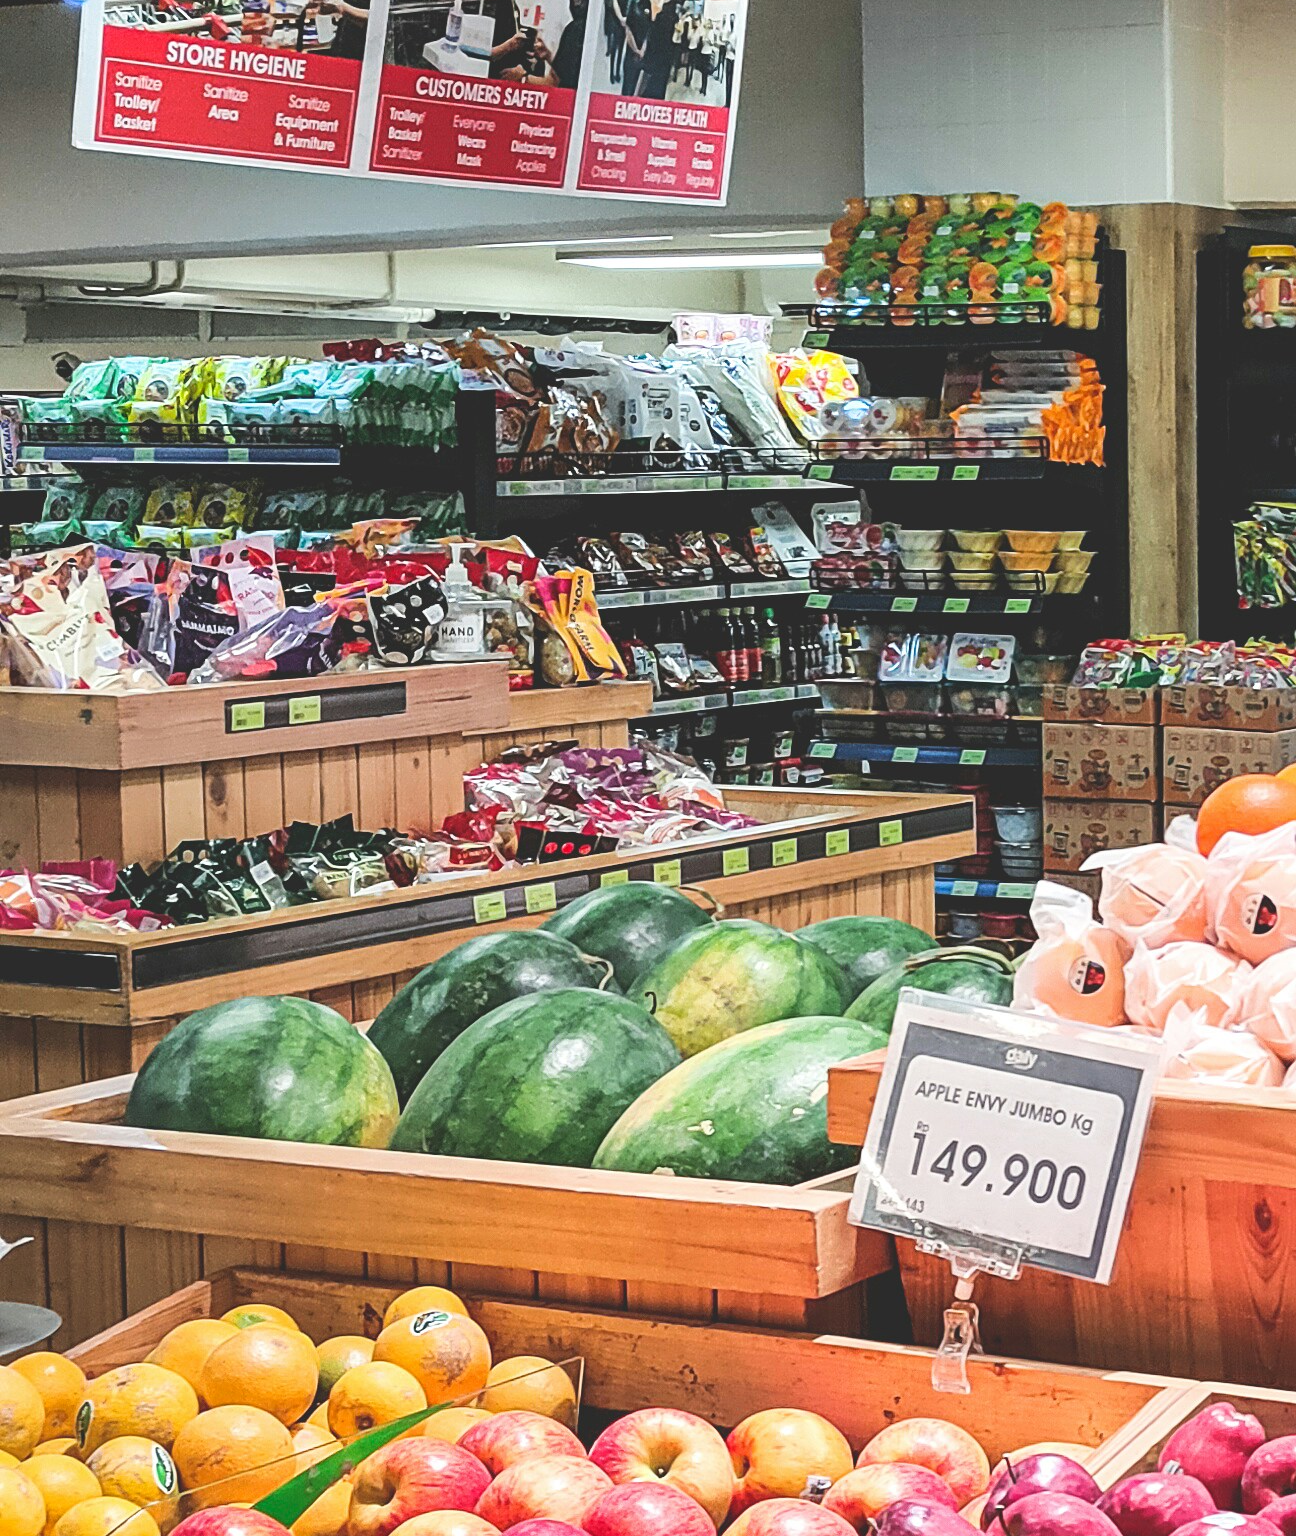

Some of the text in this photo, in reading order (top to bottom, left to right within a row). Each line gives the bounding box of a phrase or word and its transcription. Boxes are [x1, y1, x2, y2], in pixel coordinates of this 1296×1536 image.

[166, 41, 307, 79] STORE HYGIENE
[115, 72, 163, 92] Sanitize
[203, 83, 249, 103] Sanitize
[415, 76, 549, 110] CUSTOMERS SAFETY
[208, 105, 239, 121] Area
[288, 94, 331, 113] Sanitize
[113, 114, 157, 132] Basket
[275, 112, 339, 133] Equipment
[614, 101, 709, 128] EMPLOYEES HEALTH
[273, 132, 335, 152] & Furniture
[441, 626, 474, 636] HAND
[915, 1080, 1094, 1135] APPLE ENVY JUMBO Kg
[916, 1120, 930, 1133] Rp
[911, 1132, 1087, 1211] 149.900
